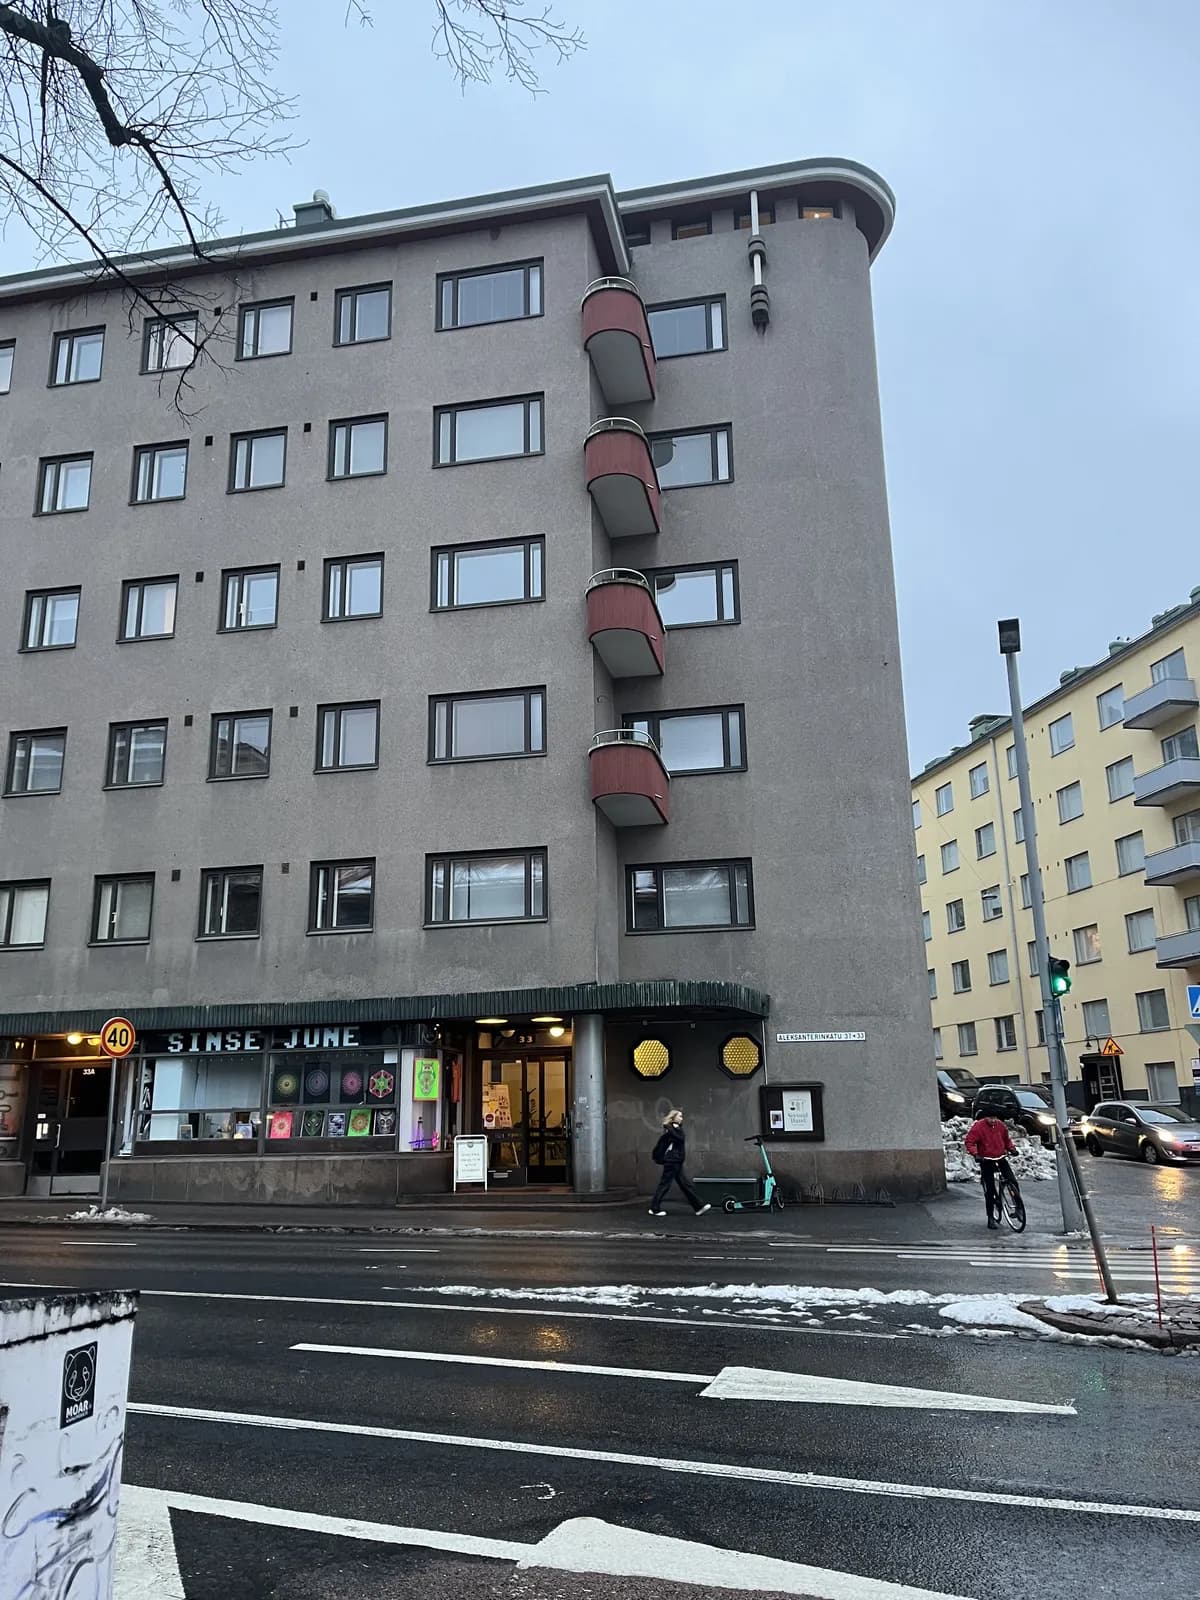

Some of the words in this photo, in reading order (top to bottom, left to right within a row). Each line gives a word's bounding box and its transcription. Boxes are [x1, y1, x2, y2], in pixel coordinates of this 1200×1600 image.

[108, 1028, 129, 1047] 40
[168, 1031, 260, 1052] SINSE
[284, 1026, 360, 1049] JUNE
[66, 1400, 88, 1418] MOAR
